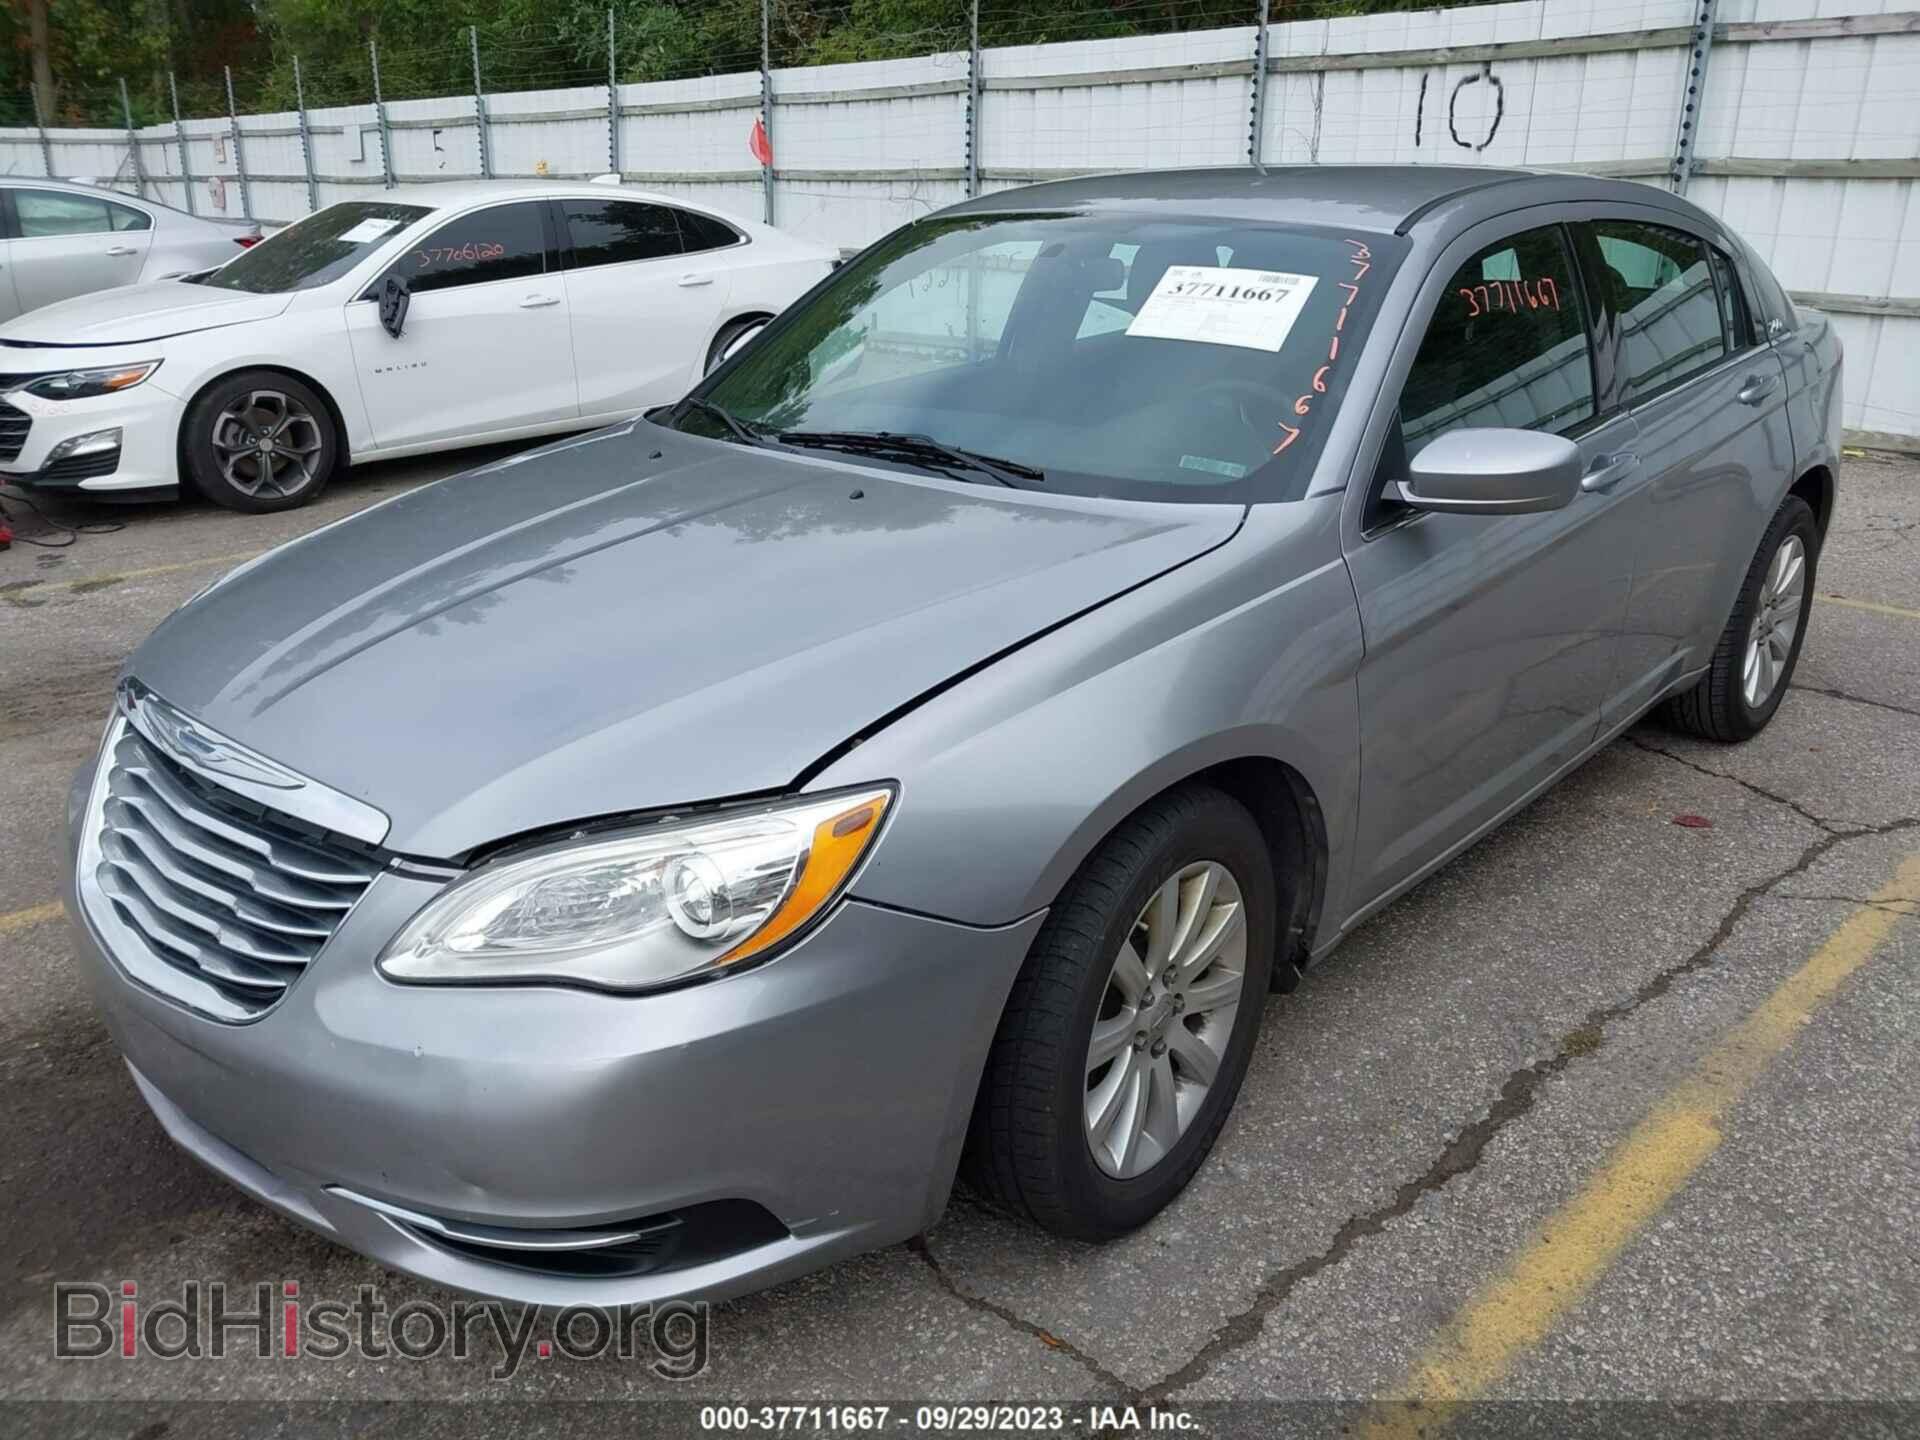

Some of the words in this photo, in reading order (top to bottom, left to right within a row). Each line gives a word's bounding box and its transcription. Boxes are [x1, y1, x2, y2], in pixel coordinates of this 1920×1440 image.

[1416, 62, 1504, 152] 10
[414, 242, 505, 268] 37706120
[1167, 281, 1291, 304] 37711667
[1459, 277, 1560, 317] 37711667
[1273, 238, 1371, 455] 37711667
